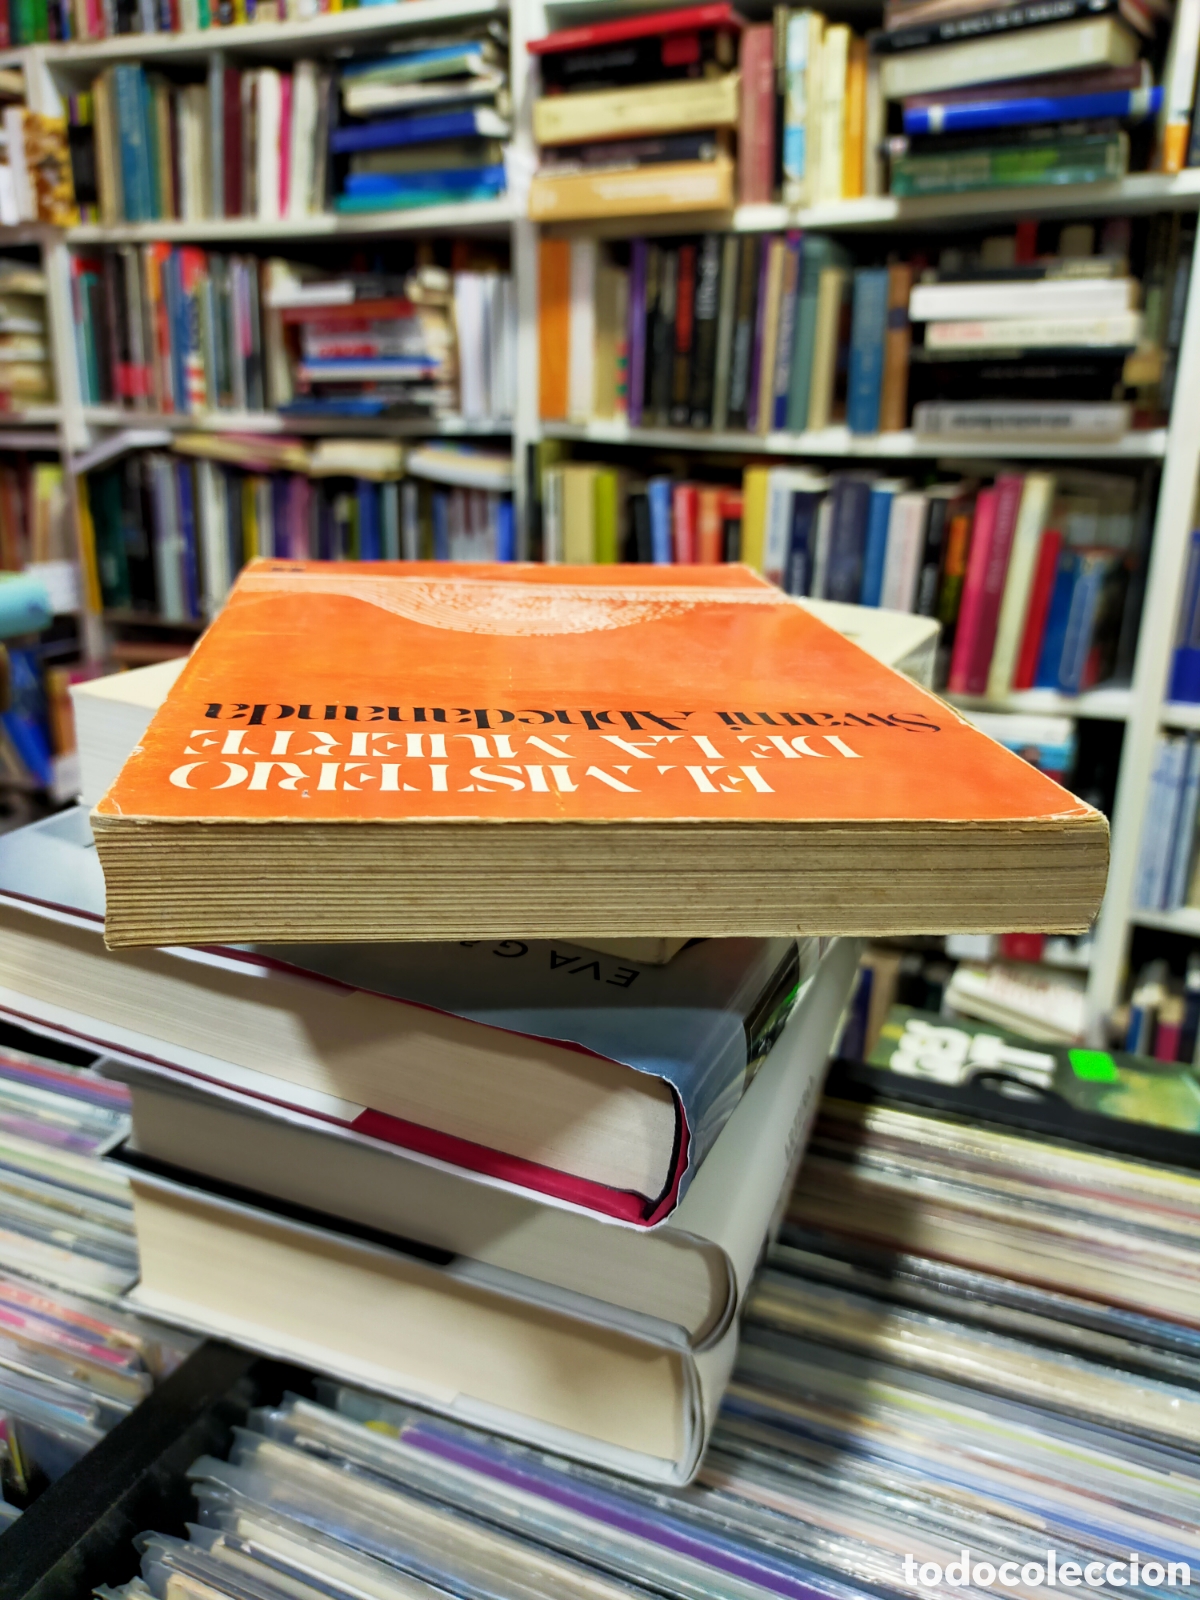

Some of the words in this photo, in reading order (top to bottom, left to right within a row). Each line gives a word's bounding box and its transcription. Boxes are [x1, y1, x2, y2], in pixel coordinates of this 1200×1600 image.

[204, 702, 696, 731] Abhedananda
[714, 710, 942, 733] Swami
[183, 729, 577, 759] MUERTE
[599, 734, 725, 759] LA
[739, 735, 864, 759] DE
[169, 760, 643, 793] MISTERIO
[657, 765, 776, 793] EL
[550, 950, 640, 988] EVA
